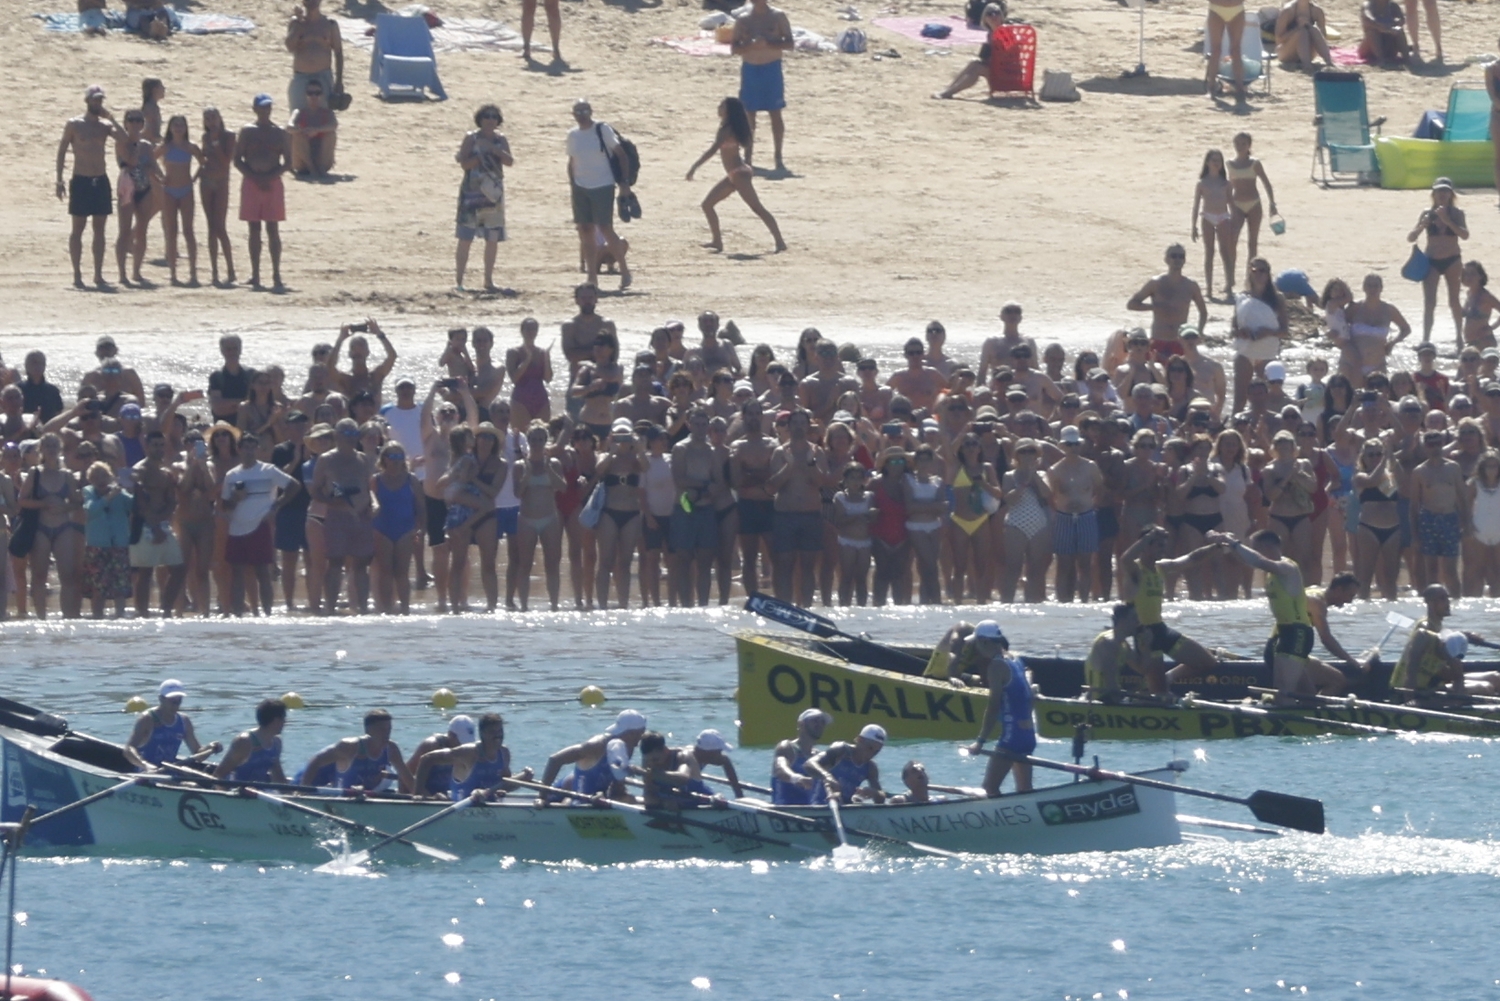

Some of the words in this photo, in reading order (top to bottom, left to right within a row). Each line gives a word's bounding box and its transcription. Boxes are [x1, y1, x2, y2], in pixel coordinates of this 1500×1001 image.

[766, 663, 977, 724] ORIALKI
[1044, 709, 1182, 732] ORBINOX
[1064, 791, 1135, 820] Ryde
